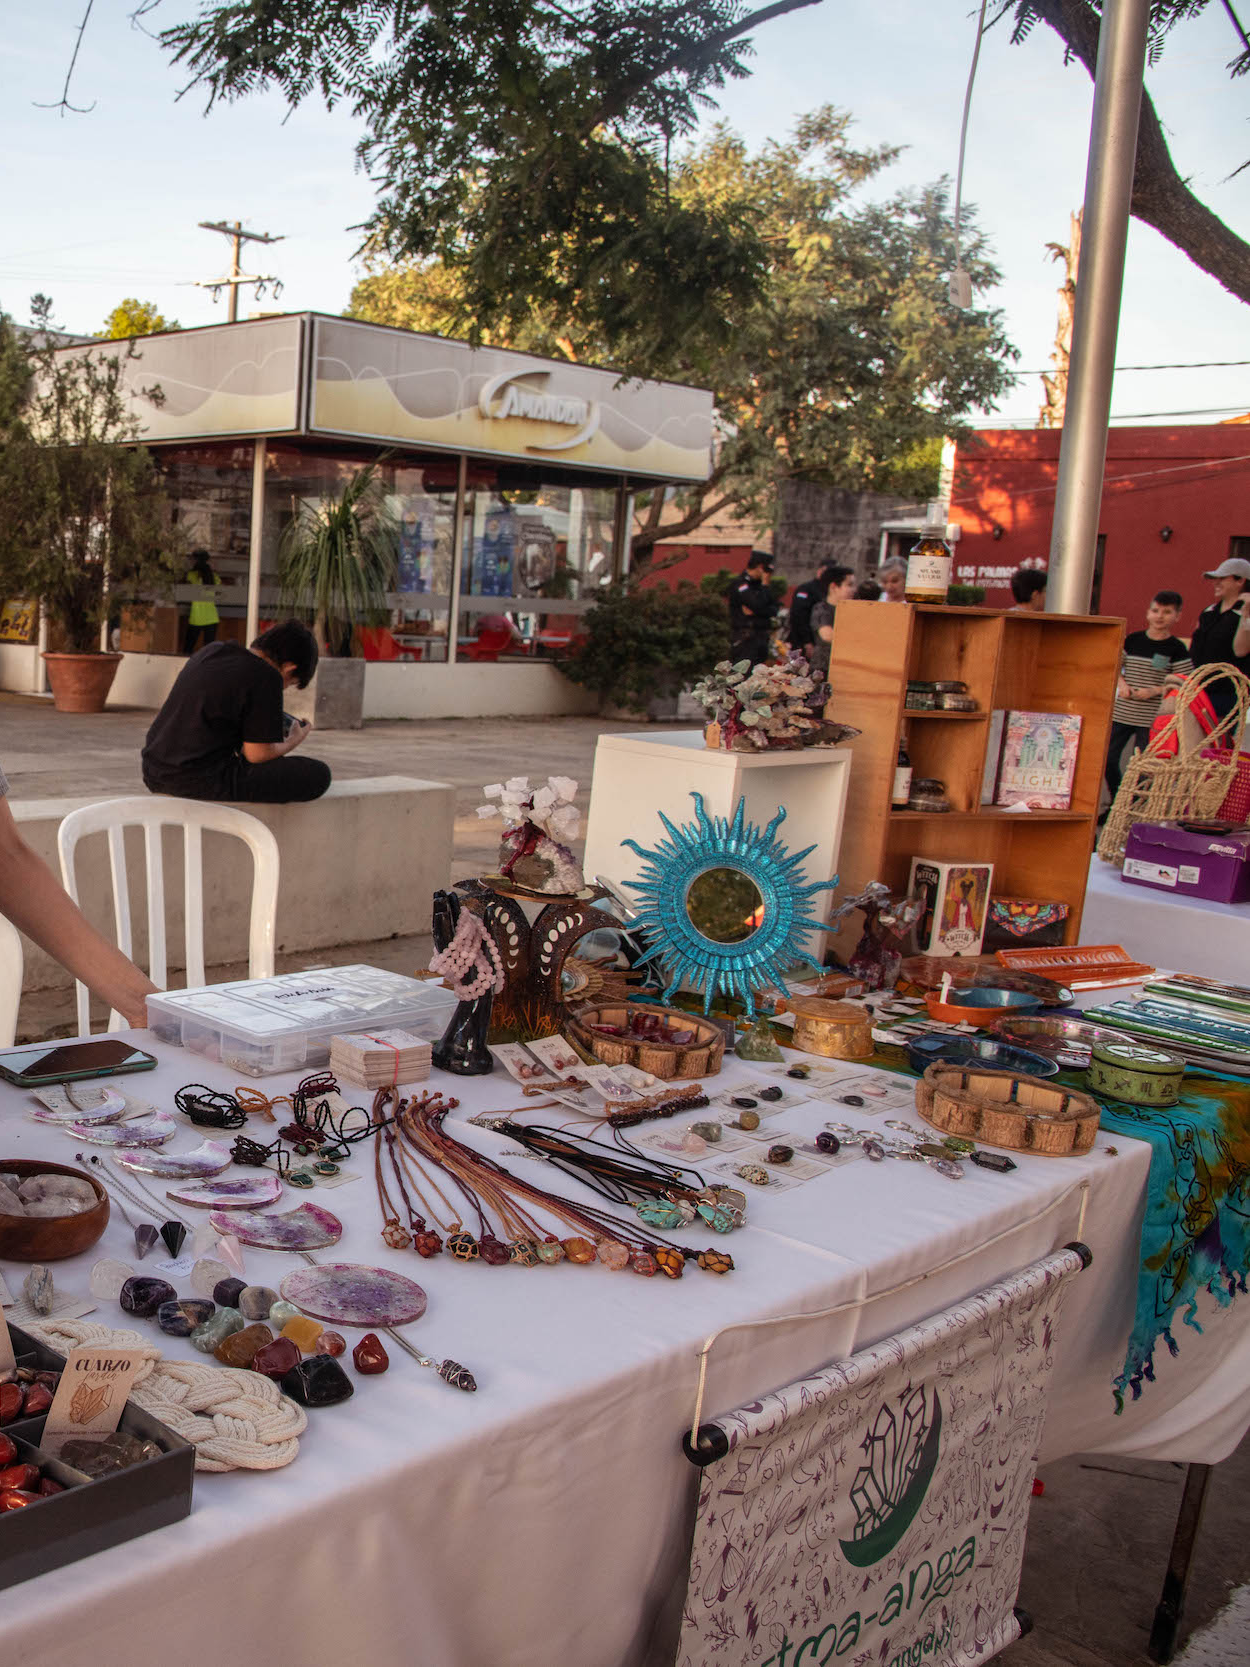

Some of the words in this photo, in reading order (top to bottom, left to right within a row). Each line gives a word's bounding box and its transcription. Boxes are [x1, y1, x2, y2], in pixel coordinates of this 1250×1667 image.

[1011, 775, 1064, 788] LIGHT
[916, 870, 938, 884] WITCH
[75, 1359, 131, 1372] CUARZO
[761, 1535, 976, 1667] tma-anga
